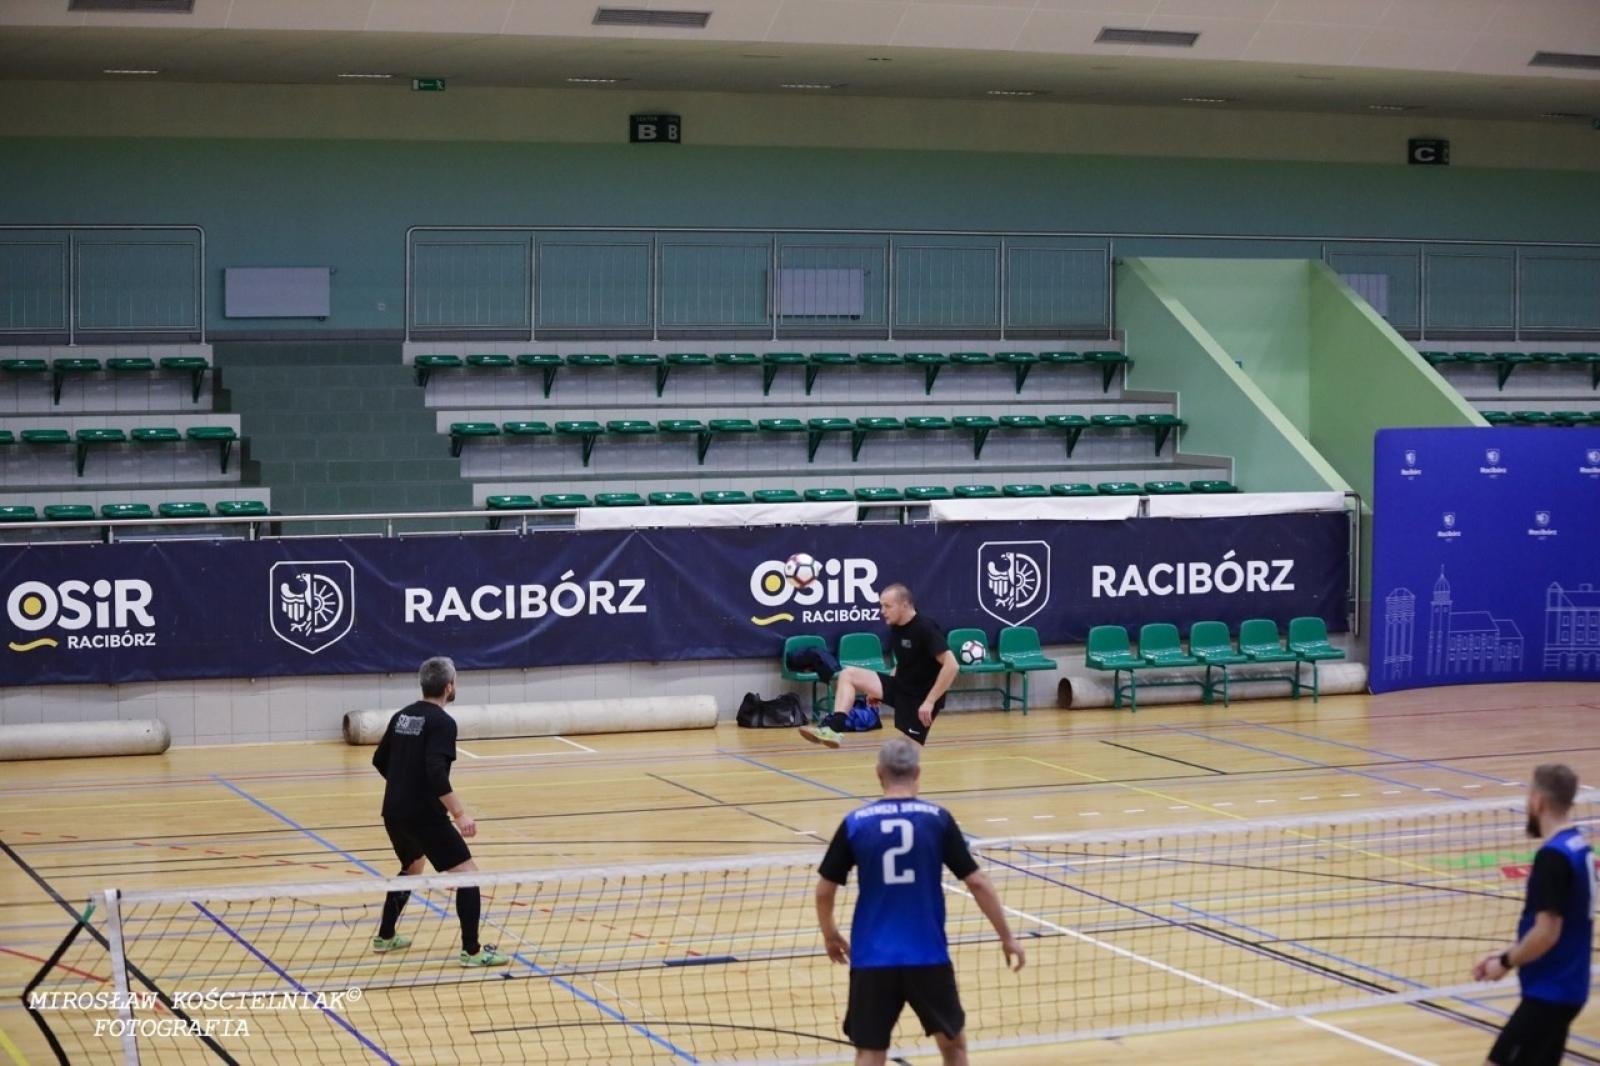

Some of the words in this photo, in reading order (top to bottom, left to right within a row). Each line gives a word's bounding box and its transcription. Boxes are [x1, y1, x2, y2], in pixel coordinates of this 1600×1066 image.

[638, 124, 657, 140] B
[668, 124, 678, 140] B
[1414, 147, 1436, 162] C
[1092, 550, 1295, 598] RACIBÓRZ
[7, 579, 156, 631] OSiR
[404, 569, 647, 623] RACIBÓRZ
[802, 605, 880, 623] RACIBÓRZ
[68, 630, 156, 649] RACIBÓRZ
[880, 819, 916, 885] 2
